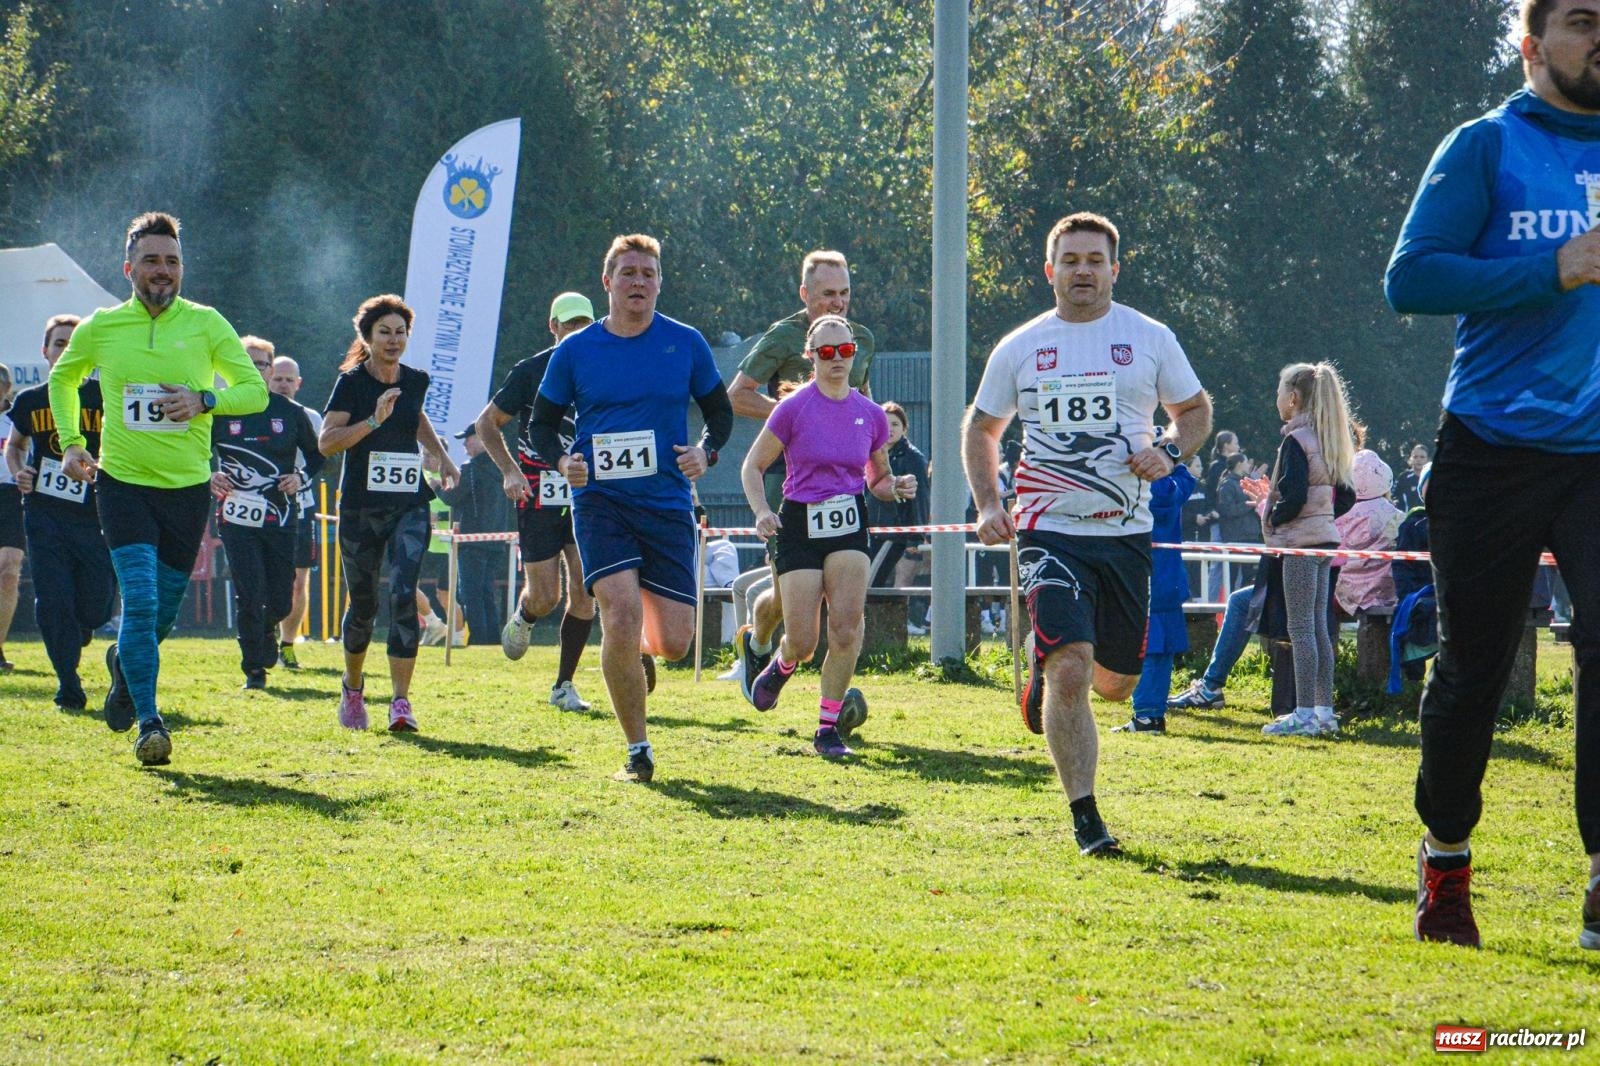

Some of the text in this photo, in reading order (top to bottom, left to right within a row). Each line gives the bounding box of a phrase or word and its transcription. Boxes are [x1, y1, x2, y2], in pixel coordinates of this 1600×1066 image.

[424, 226, 476, 423] STOWARZYSZENIE AKTYWNI DLA LEPSZEGO
[15, 366, 41, 384] DLA
[127, 400, 184, 422] 19
[1044, 395, 1112, 422] 183
[598, 447, 650, 471] 341
[43, 471, 83, 495] 193
[371, 465, 418, 485] 356
[225, 501, 262, 522] 320
[812, 507, 856, 530] 190
